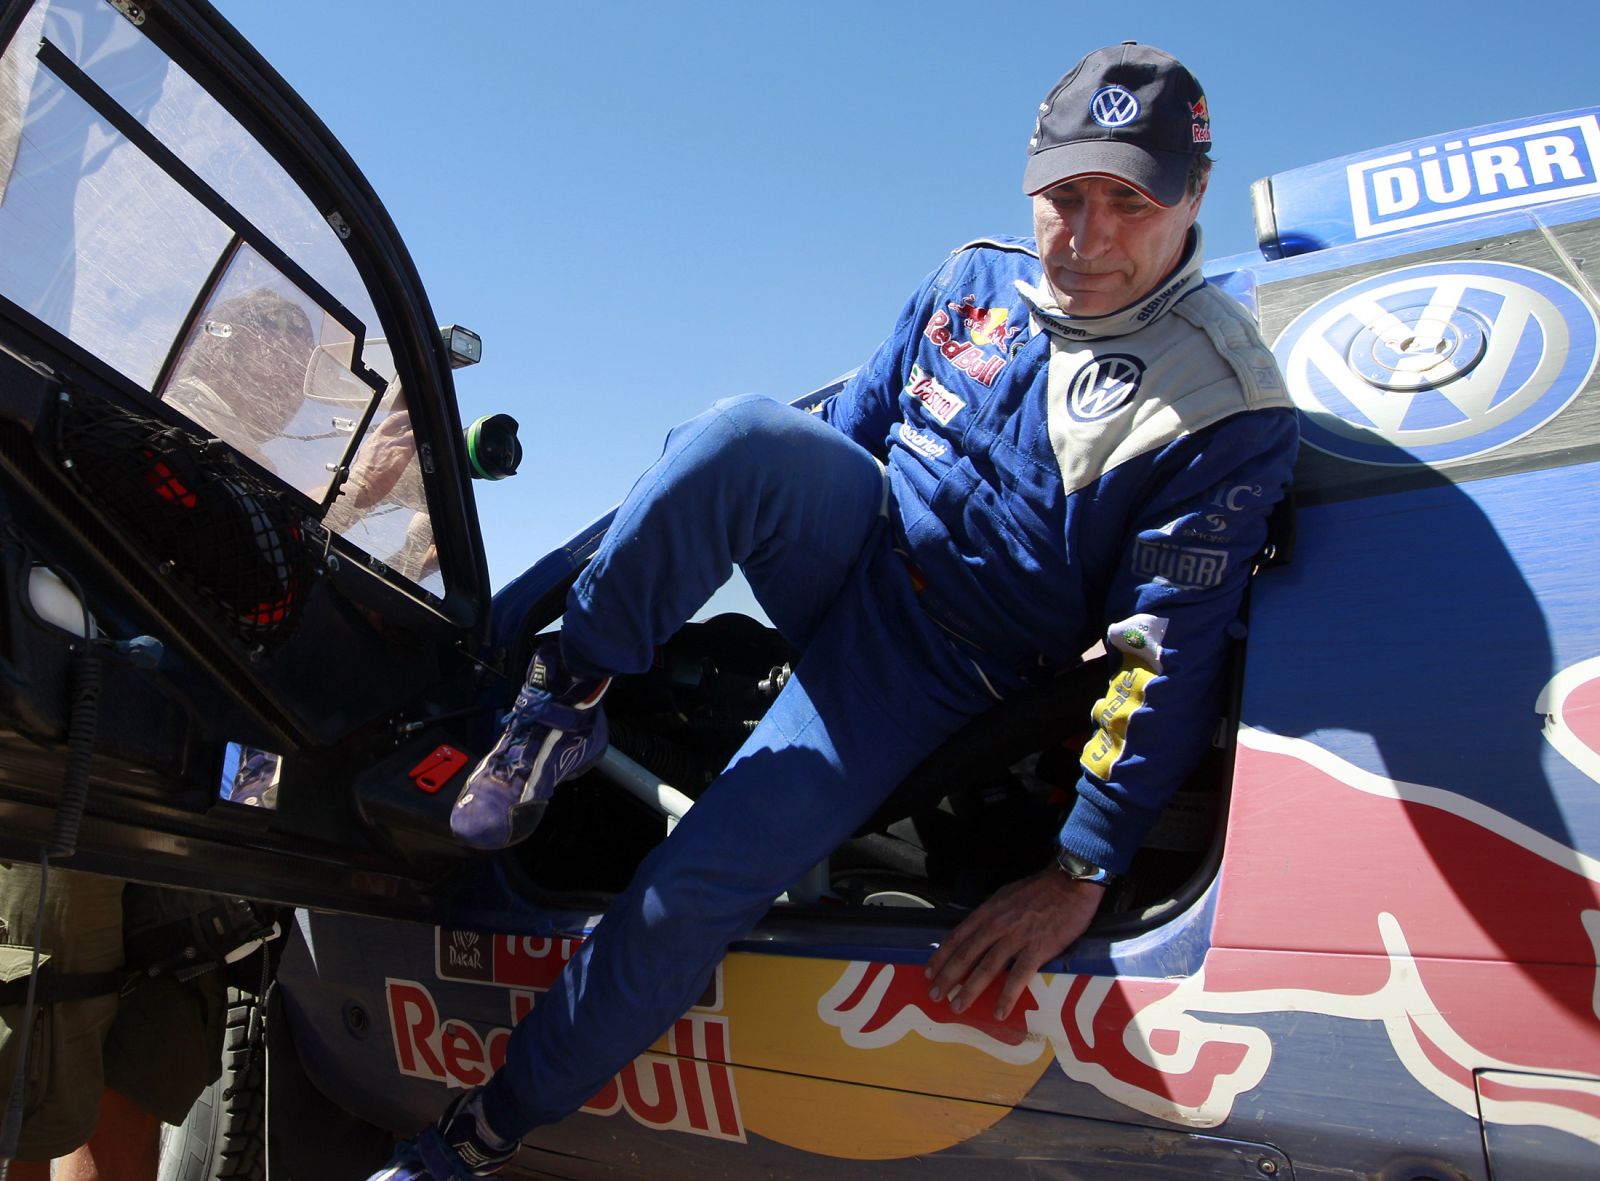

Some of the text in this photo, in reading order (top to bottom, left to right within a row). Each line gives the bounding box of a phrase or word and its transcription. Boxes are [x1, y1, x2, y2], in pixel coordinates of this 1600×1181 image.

[1373, 137, 1585, 216] DÜRR
[924, 309, 1006, 387] Red Bull
[912, 378, 958, 420] Castrol
[1140, 543, 1217, 586] DÜRR
[578, 1013, 746, 1140] ull
